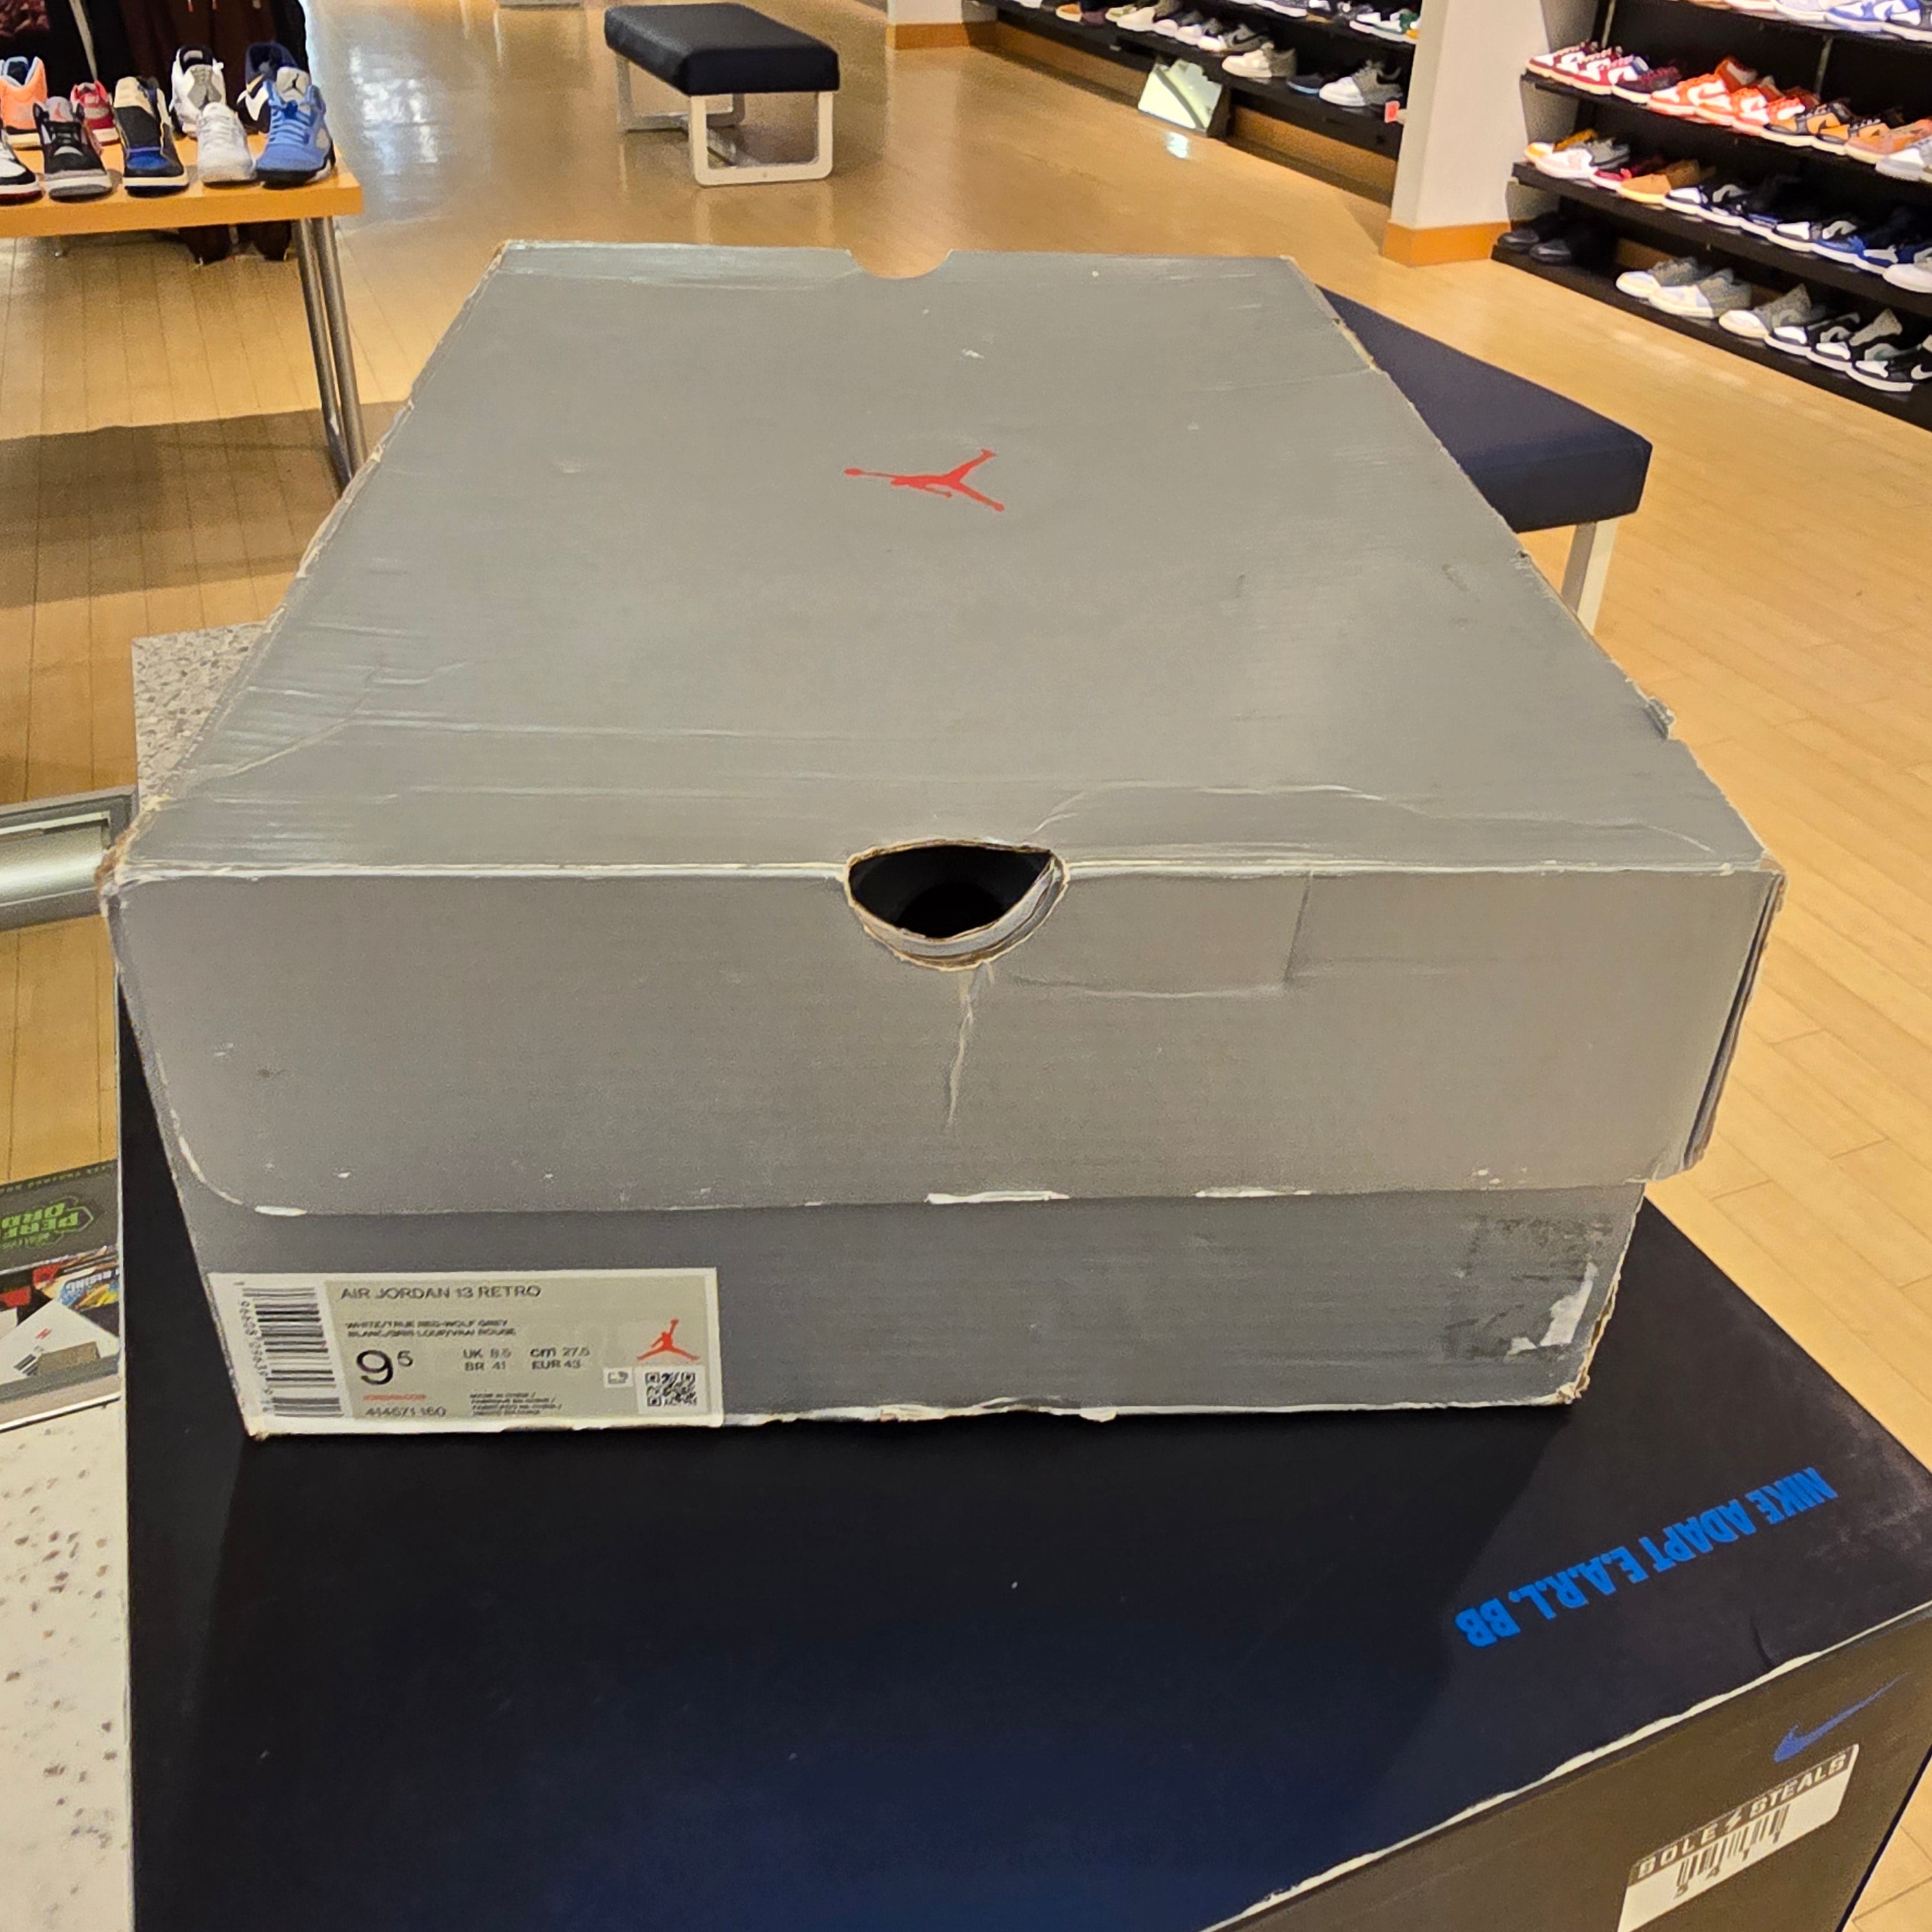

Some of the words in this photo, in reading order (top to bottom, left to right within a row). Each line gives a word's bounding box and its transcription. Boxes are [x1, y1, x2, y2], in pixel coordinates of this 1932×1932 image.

[340, 1287, 371, 1299] AIR
[375, 1287, 450, 1299] JORDAN
[456, 1286, 474, 1299] 13
[478, 1285, 542, 1299] RETRO
[462, 1348, 484, 1359] UK
[464, 1361, 485, 1372] BR
[529, 1347, 557, 1357] cm
[531, 1360, 560, 1370] EUR
[563, 1359, 582, 1369] 43
[1745, 1466, 1838, 1525] NIKE
[1638, 1498, 1756, 1573] ADAPT
[1507, 1546, 1649, 1620] E.A.R.L.
[1454, 1598, 1521, 1648] BB
[1638, 1822, 1718, 1879] SOLE
[1749, 1753, 1846, 1817] STEALS
